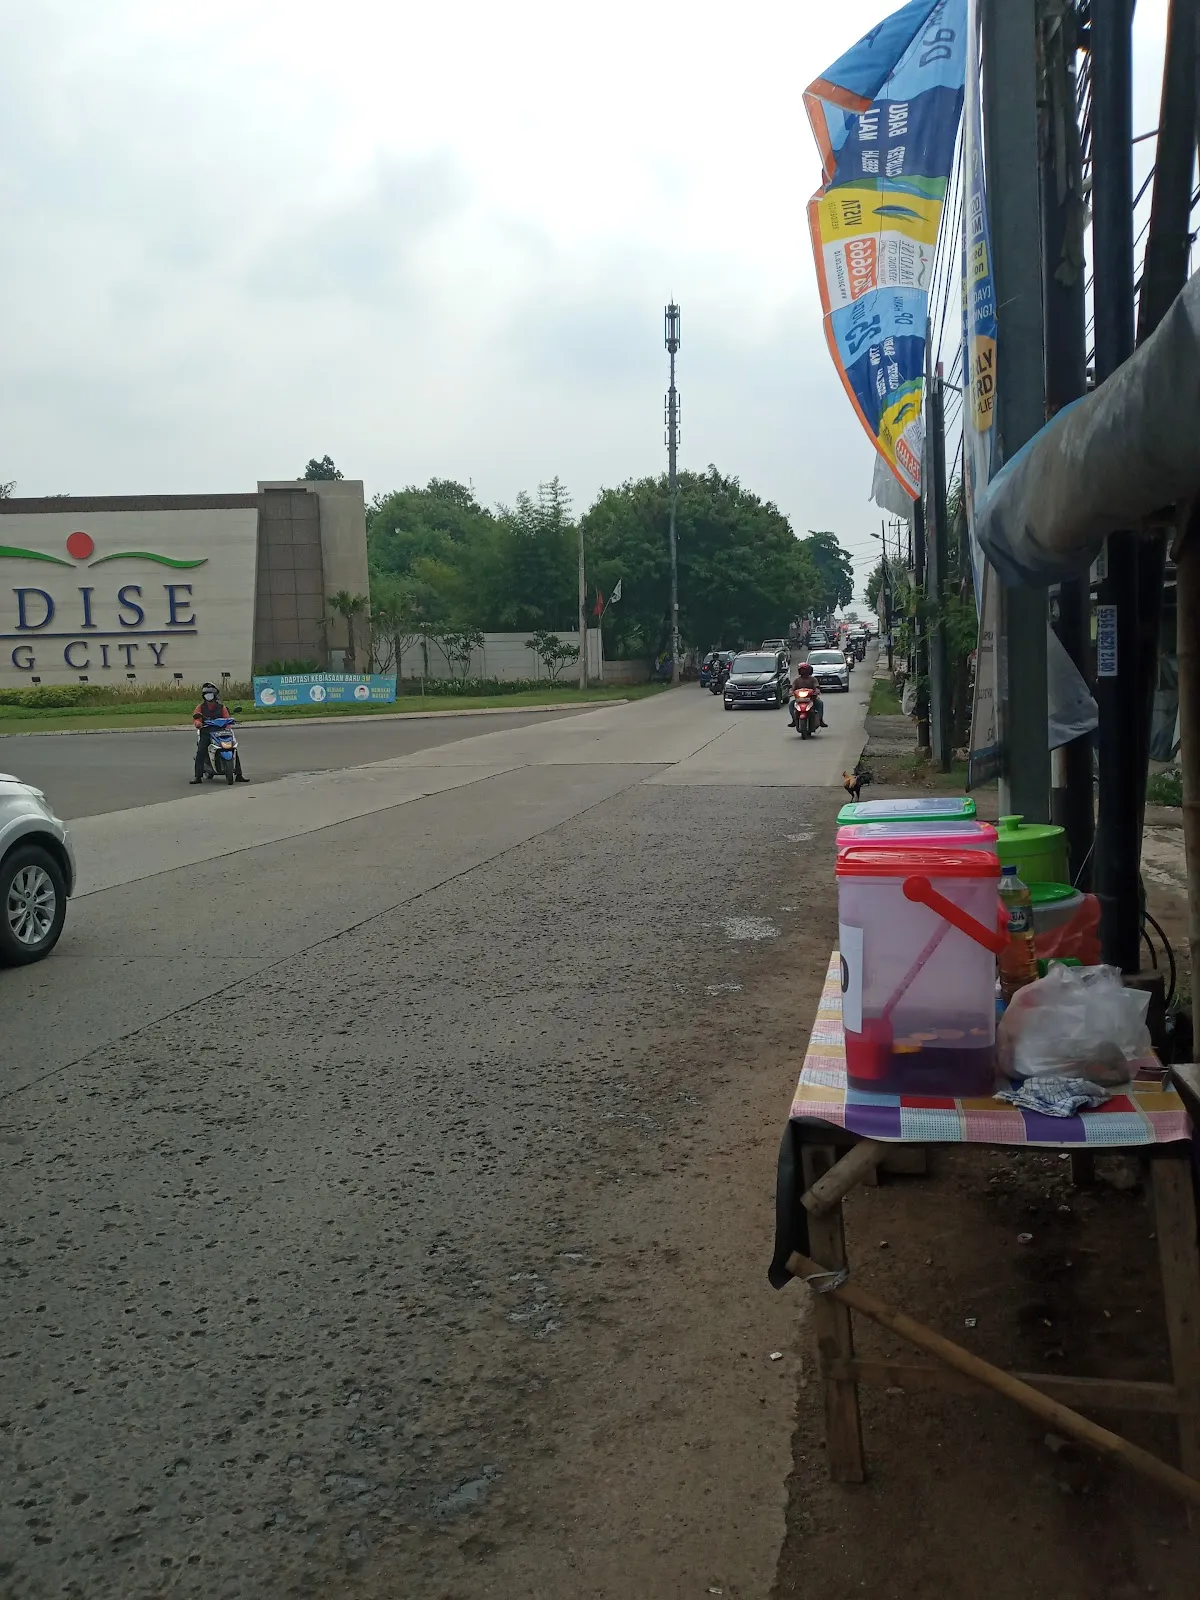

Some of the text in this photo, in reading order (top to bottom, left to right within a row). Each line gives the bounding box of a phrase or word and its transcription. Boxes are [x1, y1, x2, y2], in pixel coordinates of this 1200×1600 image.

[63, 641, 169, 669] CITY
[281, 675, 310, 684] ADAPTASI
[311, 674, 343, 682] KEBIASAAN
